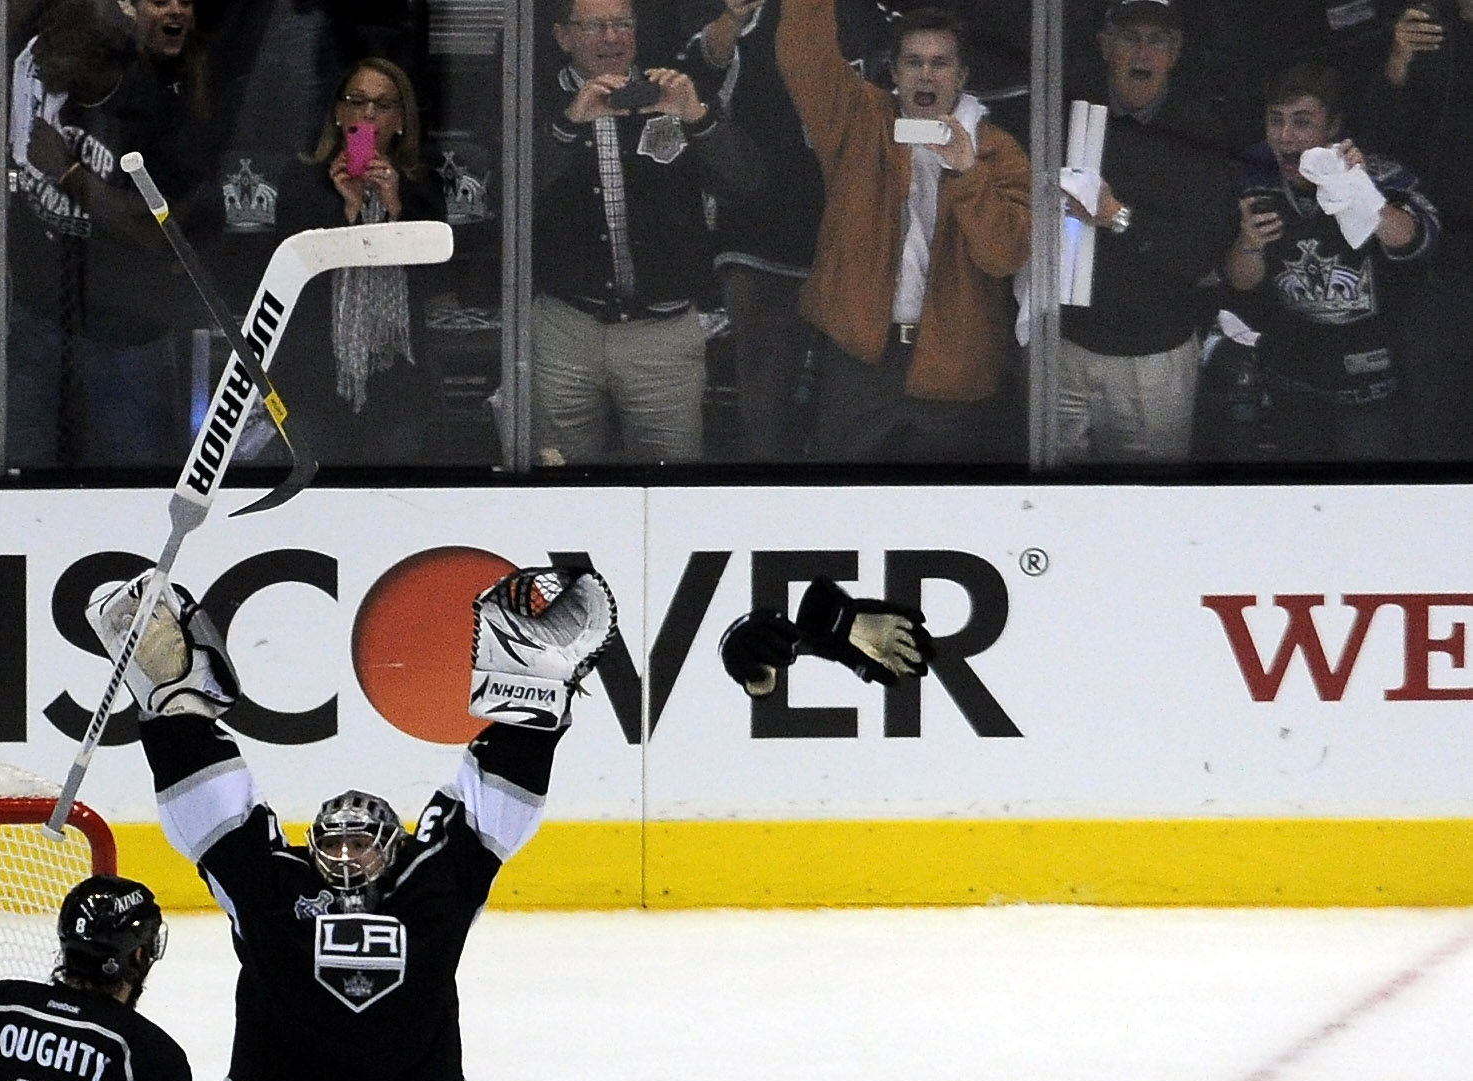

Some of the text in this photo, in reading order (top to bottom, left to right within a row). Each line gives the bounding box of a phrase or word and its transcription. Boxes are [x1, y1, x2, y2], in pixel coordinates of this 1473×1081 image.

[81, 134, 114, 179] CUP
[1200, 593, 1473, 702] WE
[489, 682, 557, 703] VAUGHN
[75, 917, 87, 934] 8
[322, 923, 399, 954] LA
